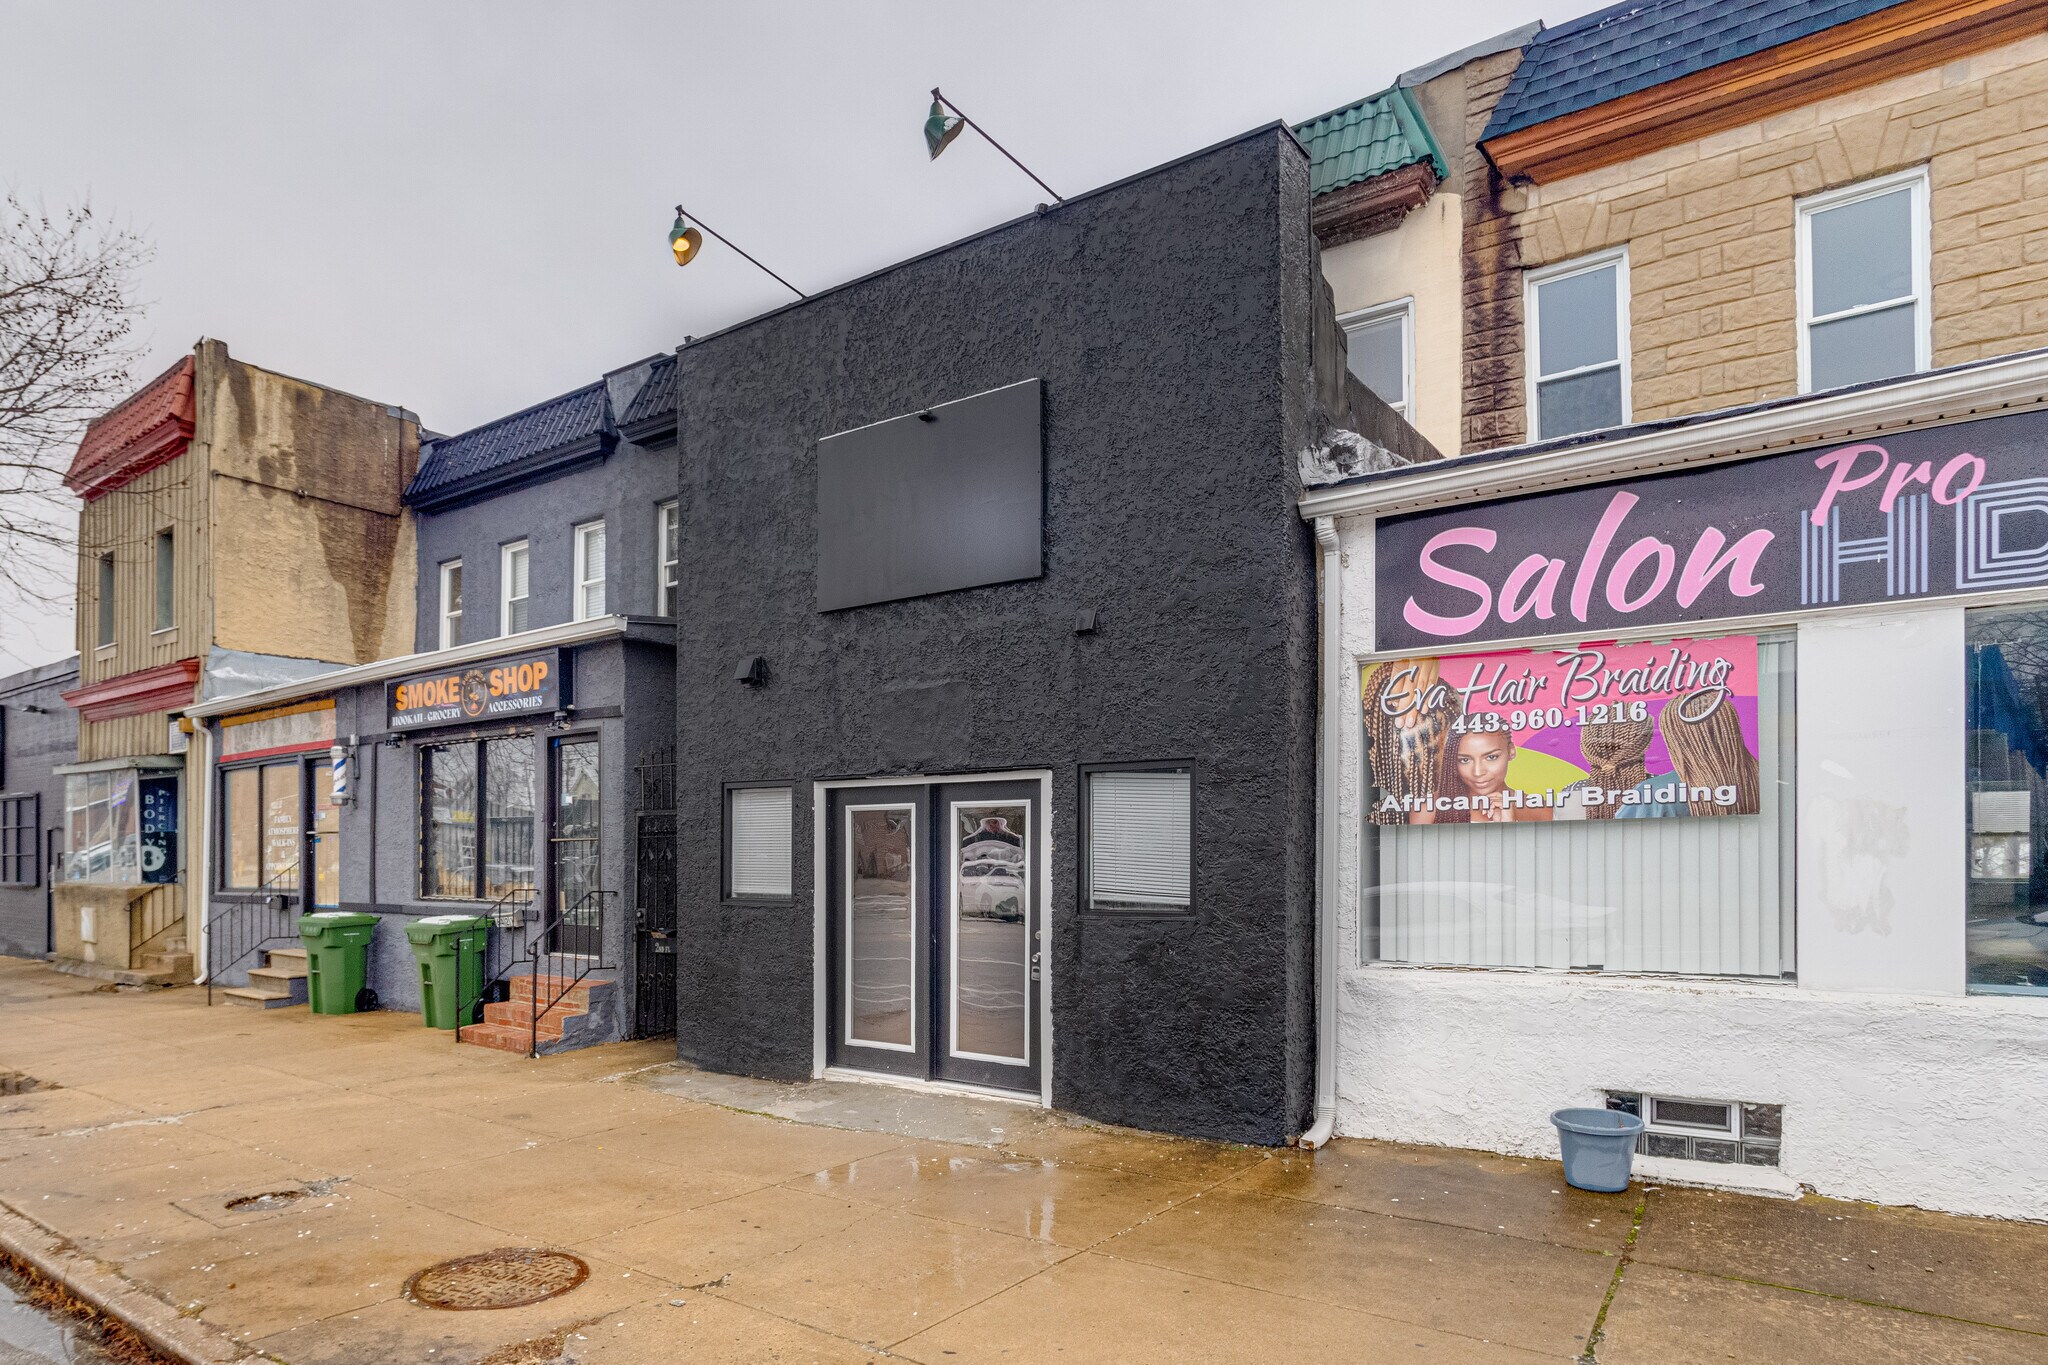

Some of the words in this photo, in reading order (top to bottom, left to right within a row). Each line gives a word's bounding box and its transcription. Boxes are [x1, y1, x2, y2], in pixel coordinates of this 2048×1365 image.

[1810, 443, 1986, 527] Pro
[1402, 490, 1776, 637] Salon
[392, 713, 424, 727] HOOKAH
[427, 707, 462, 722] GROCERY
[487, 695, 543, 714] ACCESSORIES
[395, 676, 462, 711] SMOKE
[489, 661, 549, 697] SHOP
[1380, 665, 1448, 716] Eva
[1455, 661, 1548, 716] Hair
[1556, 648, 1735, 723] Braiding
[1451, 701, 1650, 735] 443.960.1216
[143, 794, 156, 847] BODY
[1380, 793, 1491, 813] African
[1500, 787, 1571, 810] Hair
[1579, 784, 1738, 806] Braiding
